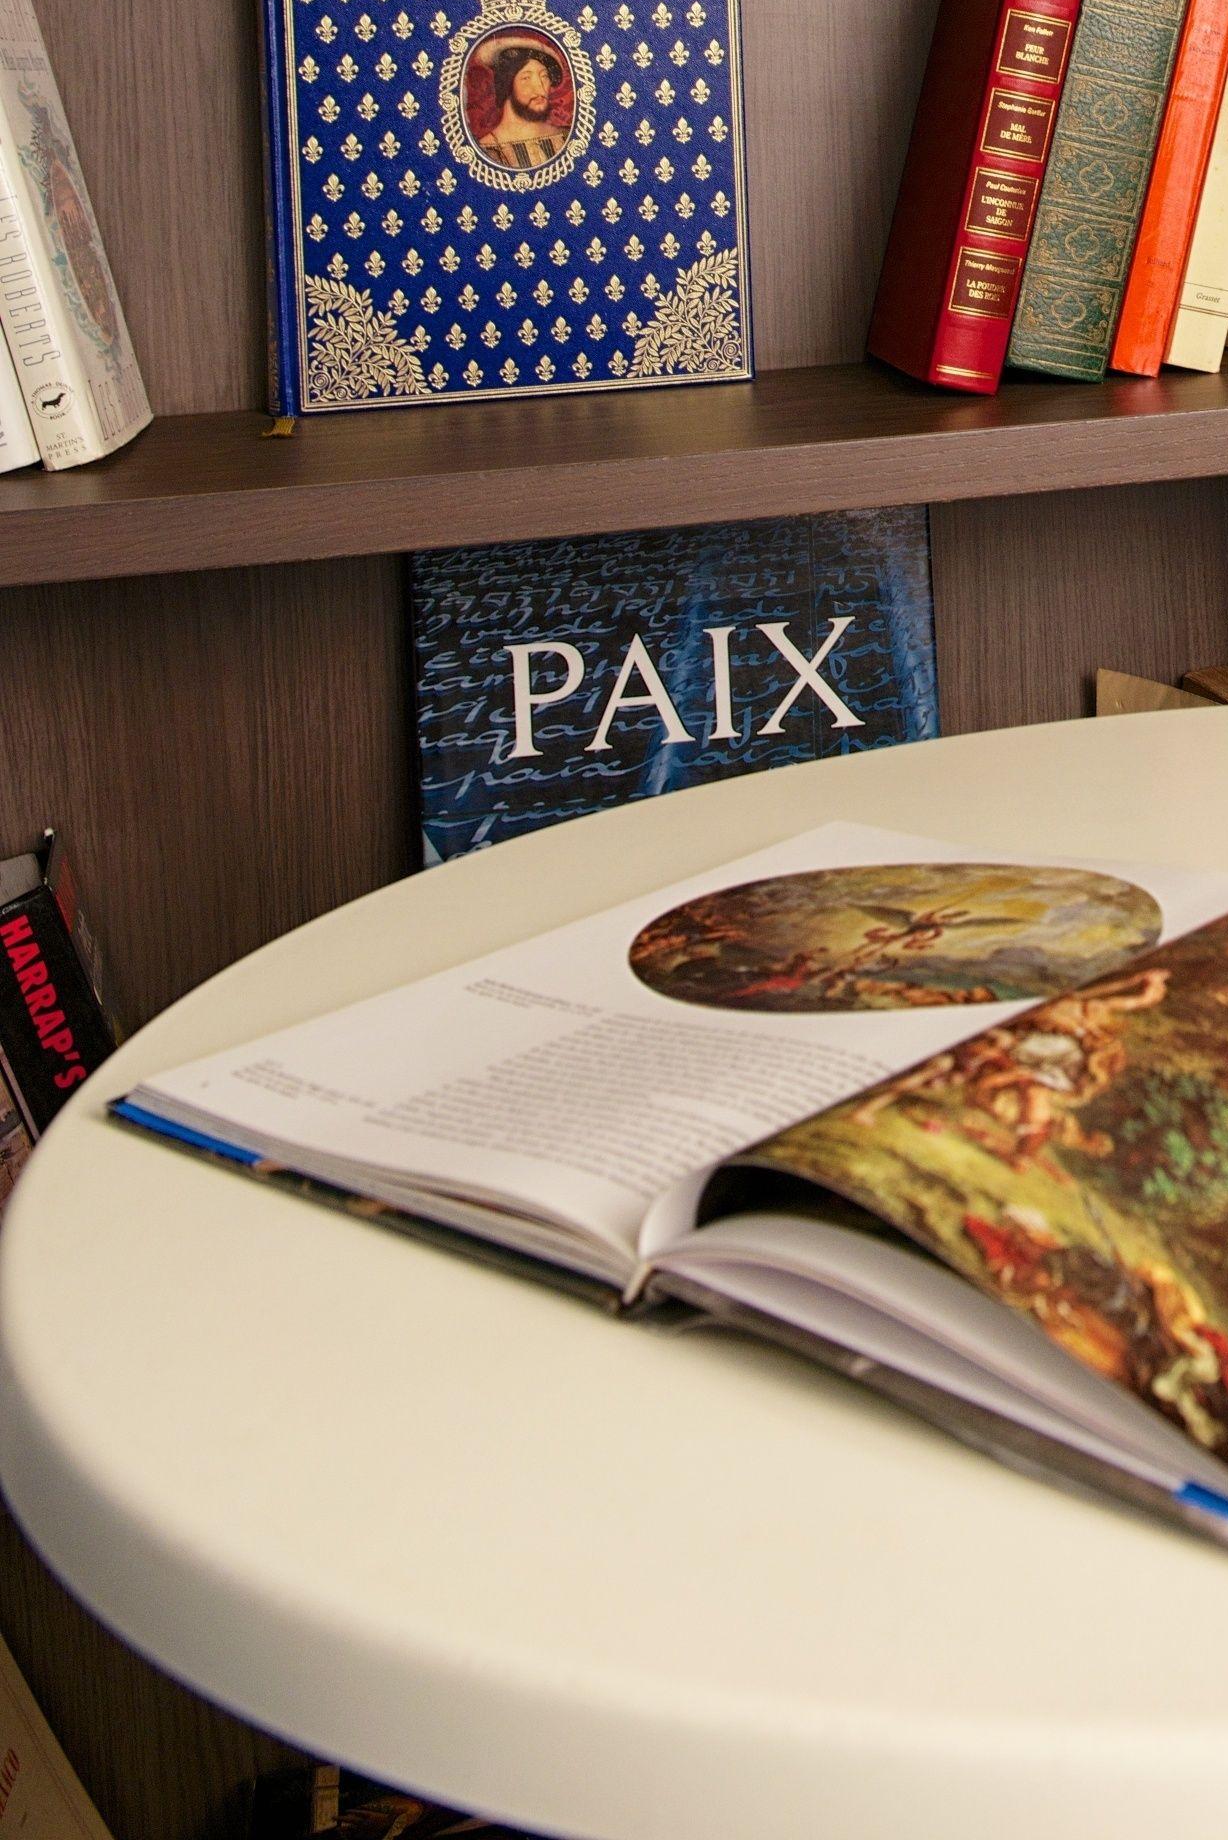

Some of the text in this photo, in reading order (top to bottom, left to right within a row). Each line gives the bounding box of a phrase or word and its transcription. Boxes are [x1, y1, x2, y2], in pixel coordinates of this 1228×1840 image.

[1024, 43, 1045, 55] PEUR
[1015, 50, 1050, 67] BLANCHE
[1009, 122, 1027, 134] MAL
[995, 207, 1008, 218] DE
[1195, 291, 1222, 305] Grasset
[45, 435, 86, 452] MARTIN'S
[47, 444, 88, 461] PRESS
[502, 615, 866, 761] PAIX
[0, 914, 88, 1090] HARRAP'S
